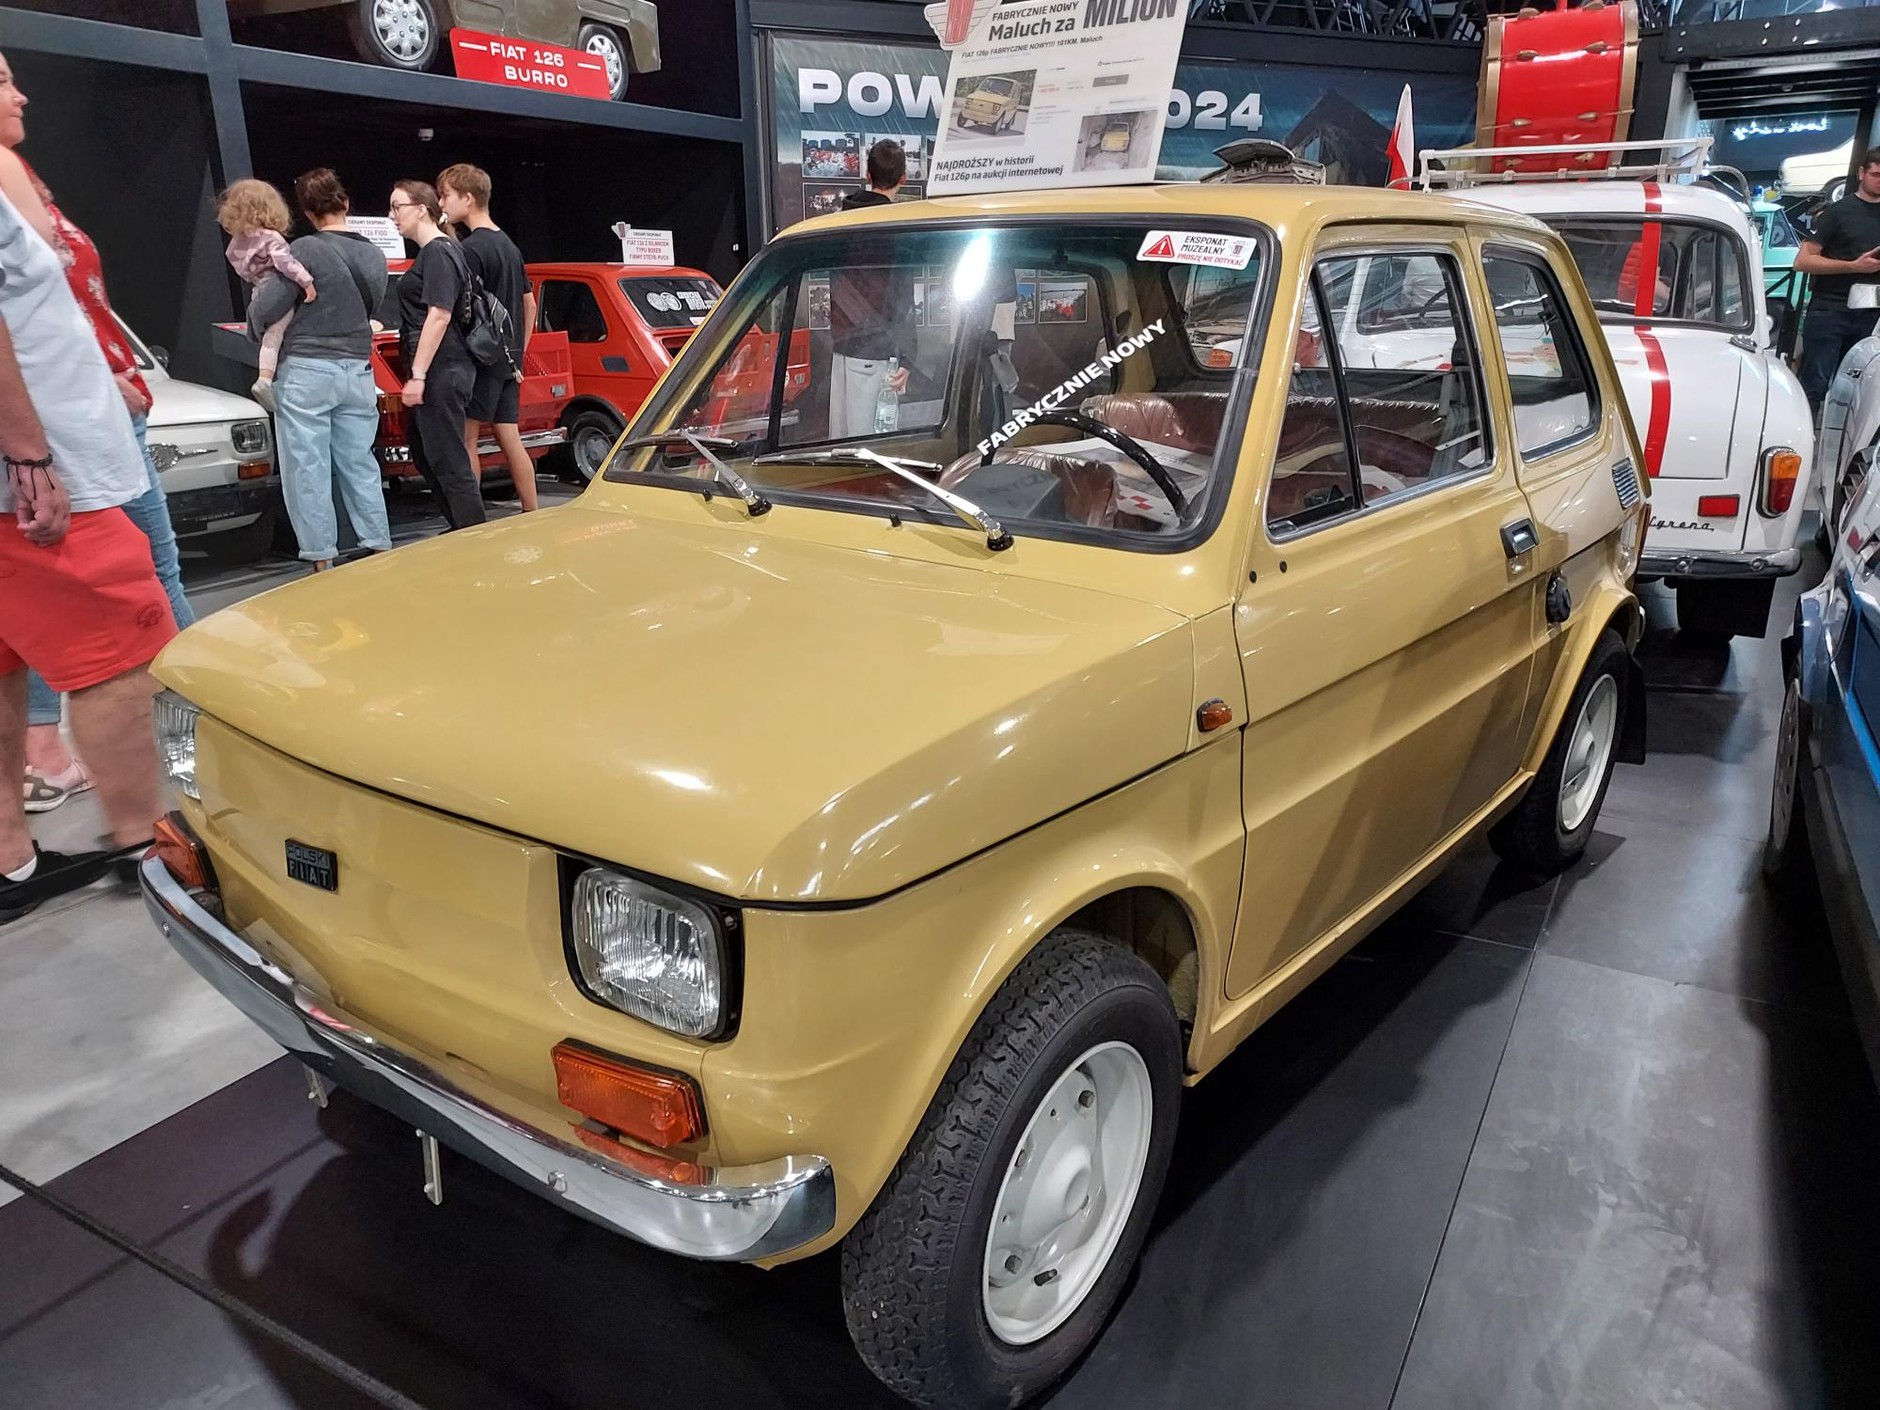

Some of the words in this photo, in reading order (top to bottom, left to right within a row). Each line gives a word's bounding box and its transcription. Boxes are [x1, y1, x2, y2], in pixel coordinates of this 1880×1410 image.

[992, 7, 1048, 21] FABRYCZNIE
[1049, 1, 1080, 14] NOWY
[988, 17, 1051, 41] Maluch
[1055, 17, 1076, 33] za
[490, 41, 527, 61] FIAT
[534, 50, 565, 67] 126
[961, 50, 976, 59] FIAT
[990, 44, 1029, 55] FABRYCZNIE
[1080, 35, 1103, 44] Maluch
[504, 65, 569, 87] BURRO
[934, 173, 950, 182] Fiat
[950, 172, 971, 181] 126p
[982, 170, 1007, 180] aukcji
[1008, 165, 1064, 178] internetowej
[936, 157, 995, 172] NAJDROŻSZY
[995, 159, 1004, 167] w
[1004, 155, 1035, 166] historii
[1180, 244, 1226, 255] MUZEALNY
[1184, 235, 1229, 246] EKSPONAT
[1177, 253, 1202, 263] PROSZĘ
[1203, 255, 1213, 263] NIE
[1214, 257, 1245, 267] DOTYKAĆ
[976, 361, 1104, 457] FABRYCZNIE
[1100, 318, 1167, 369] NOWY
[286, 843, 330, 868] POLSKI
[288, 859, 329, 887] FIAT
